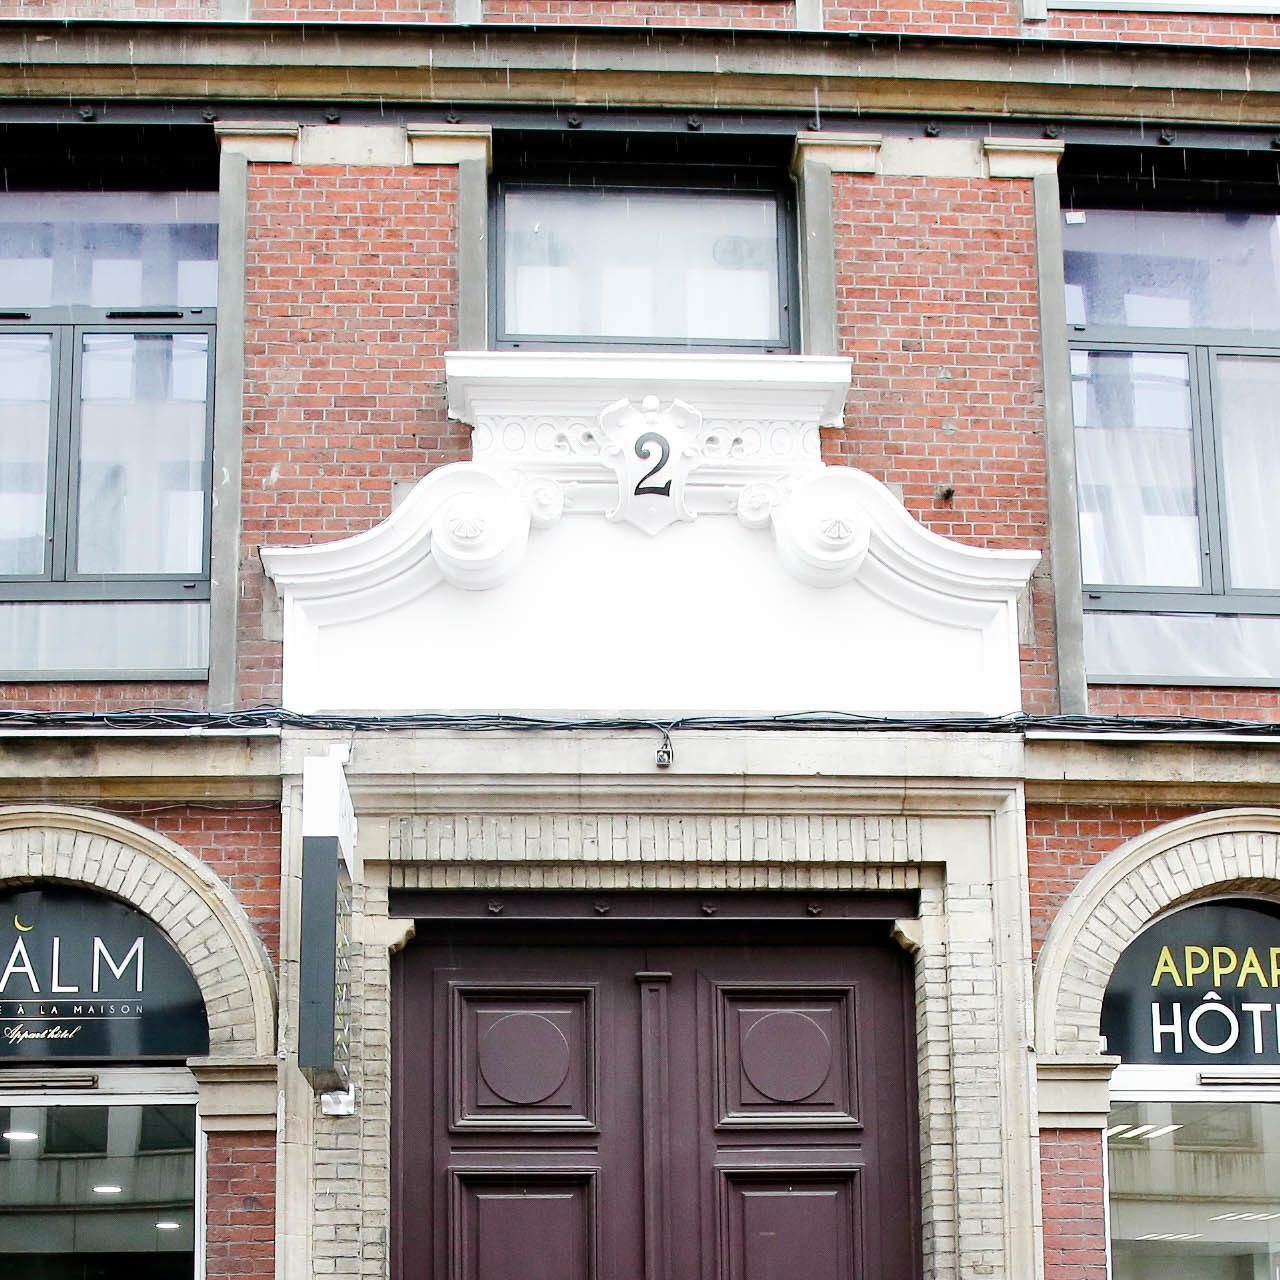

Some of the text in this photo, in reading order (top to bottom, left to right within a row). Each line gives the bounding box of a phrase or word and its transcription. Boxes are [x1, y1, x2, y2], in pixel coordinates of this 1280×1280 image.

[633, 431, 672, 497] 2
[17, 1003, 25, 1016] À
[39, 1005, 59, 1016] LA
[73, 1004, 144, 1015] MAISON
